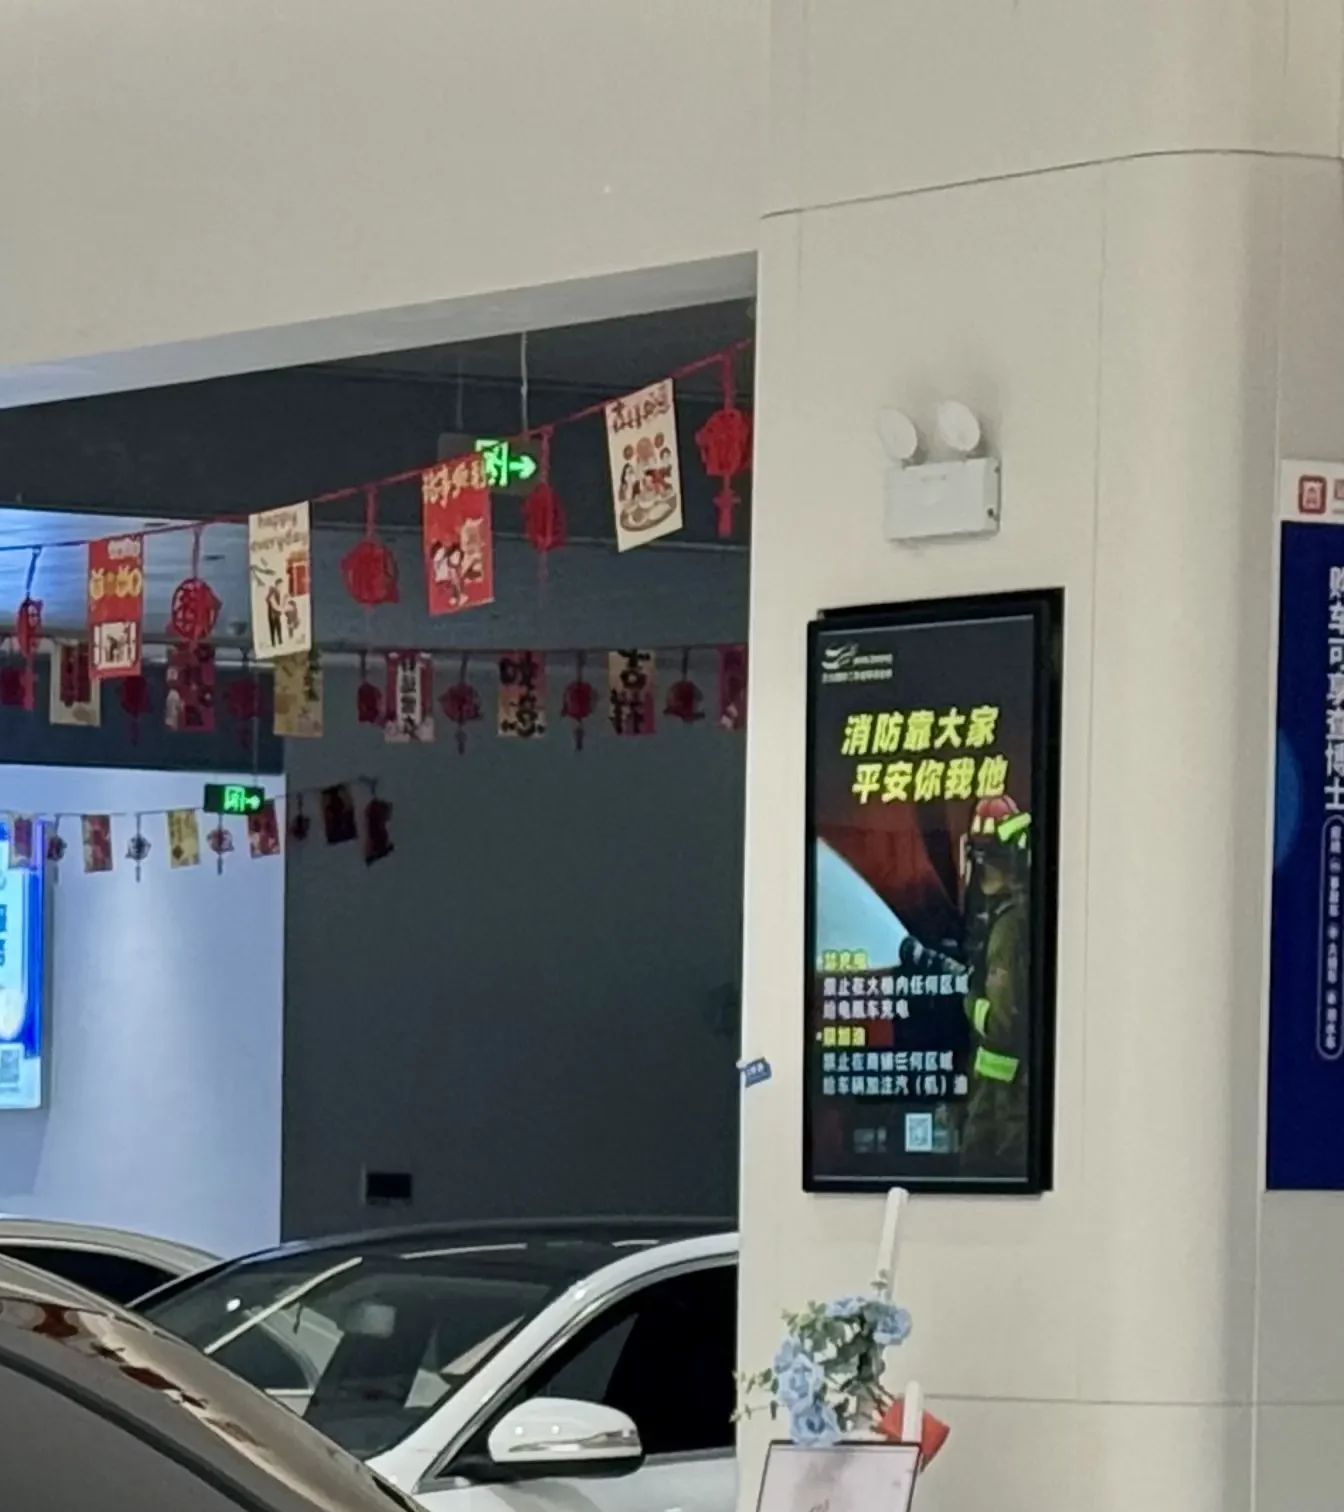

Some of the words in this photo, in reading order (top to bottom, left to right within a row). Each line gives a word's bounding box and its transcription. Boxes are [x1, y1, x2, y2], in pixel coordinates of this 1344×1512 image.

[841, 705, 998, 755] 消防靠大家
[852, 754, 1008, 804] 平安你我他
